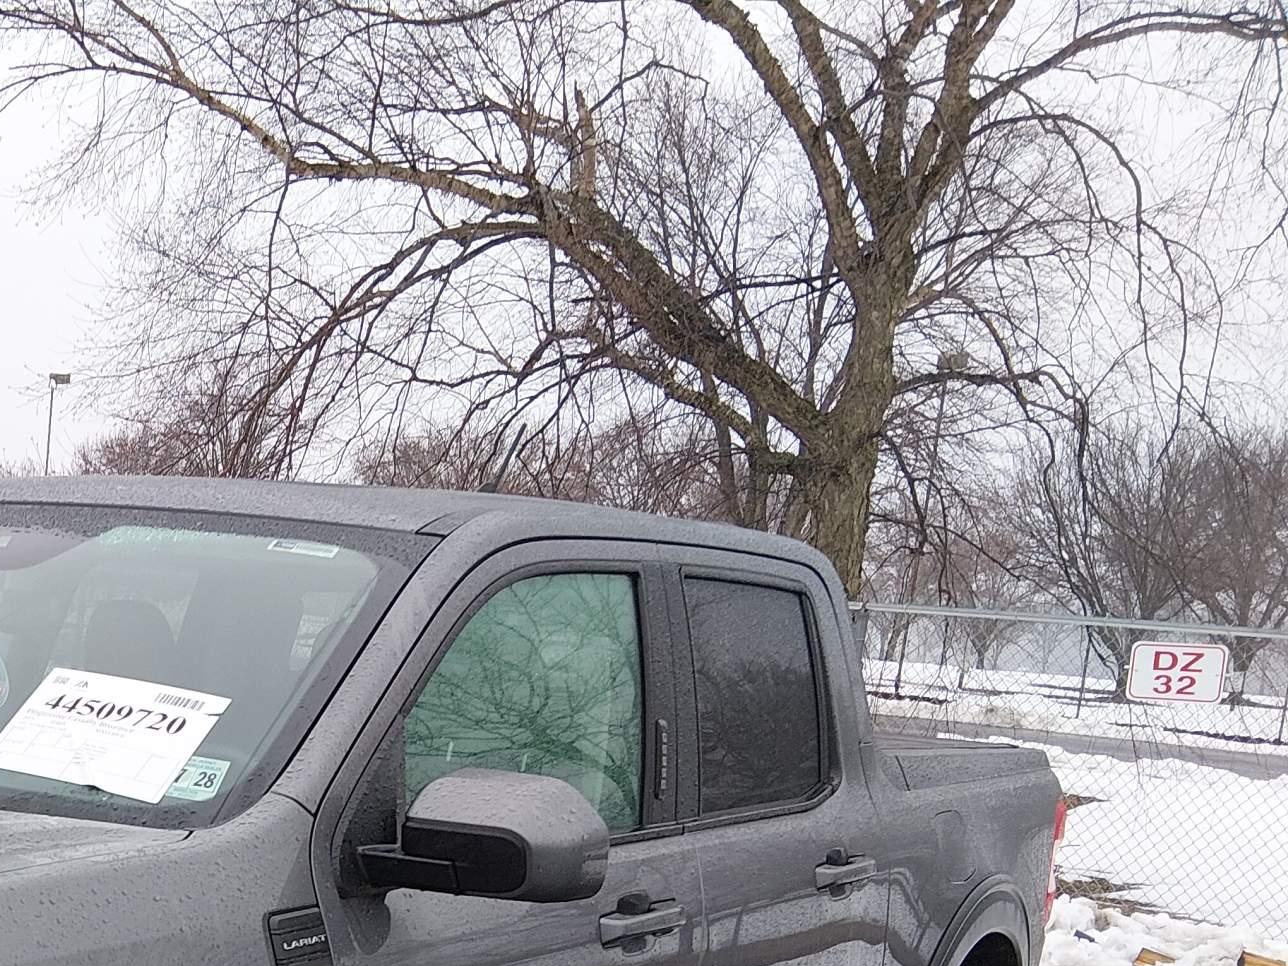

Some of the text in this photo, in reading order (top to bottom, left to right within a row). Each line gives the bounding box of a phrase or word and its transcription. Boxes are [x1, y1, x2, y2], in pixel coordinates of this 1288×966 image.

[1152, 650, 1205, 673] DZ
[1152, 674, 1197, 695] 32
[45, 693, 187, 735] 44509720
[193, 771, 217, 789] 28
[282, 933, 327, 951] LARIAT
